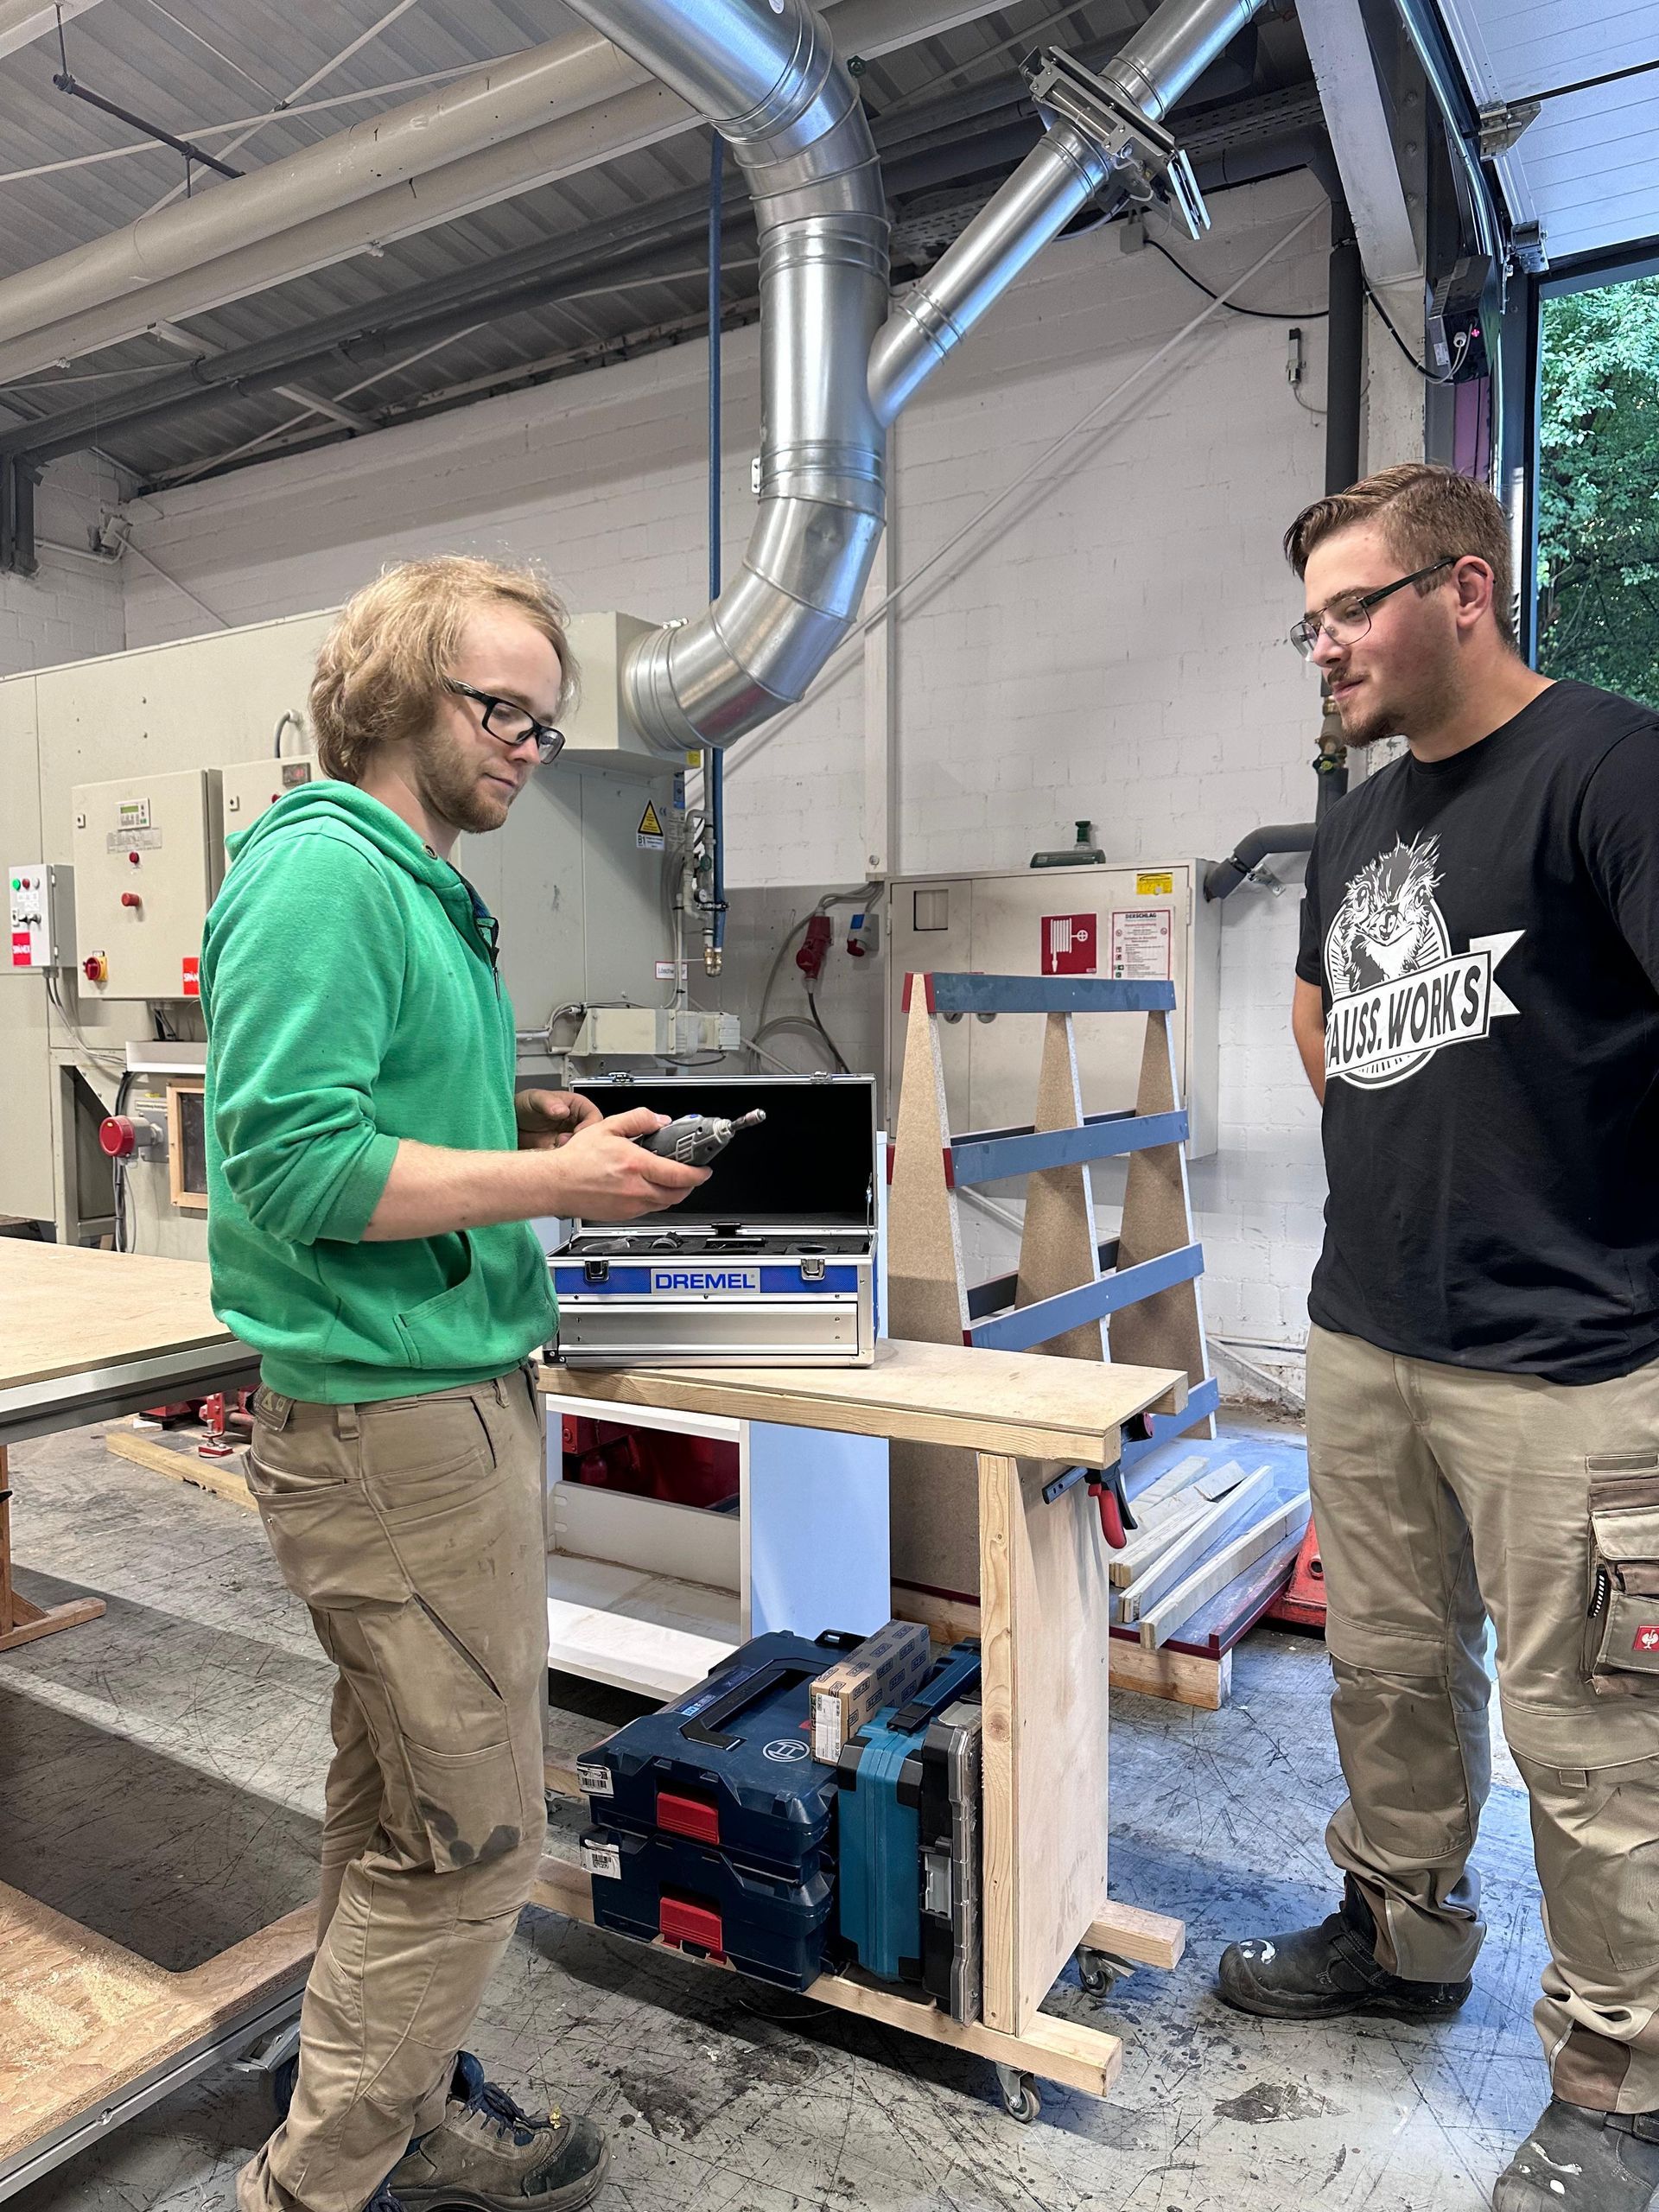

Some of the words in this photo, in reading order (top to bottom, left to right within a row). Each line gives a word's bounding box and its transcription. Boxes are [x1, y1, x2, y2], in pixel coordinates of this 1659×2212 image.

[1325, 996, 1382, 1069] AUSS.
[1388, 964, 1482, 1050] WORKS
[655, 1273, 756, 1289] DREMEL
